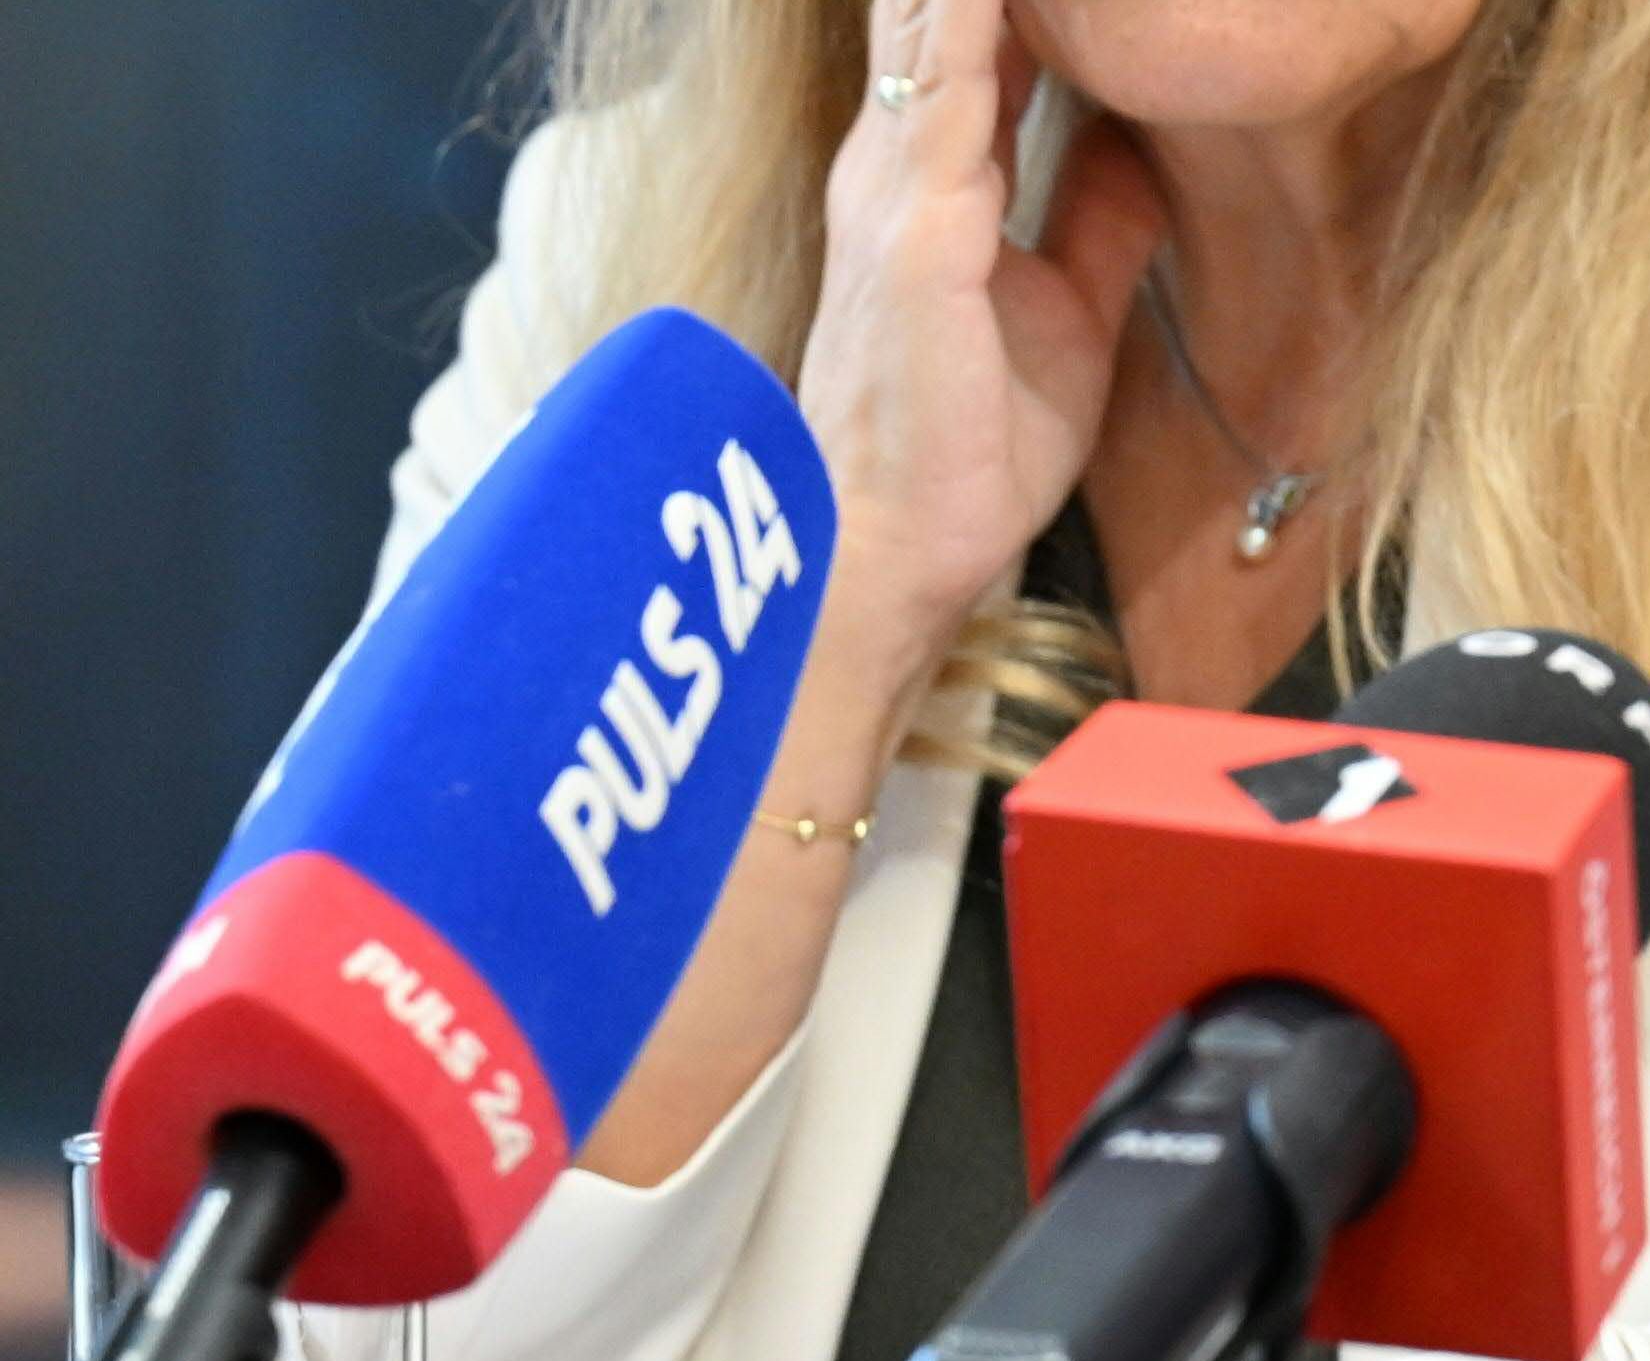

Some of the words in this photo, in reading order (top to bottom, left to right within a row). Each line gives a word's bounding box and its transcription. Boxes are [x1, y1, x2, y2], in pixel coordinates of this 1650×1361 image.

[540, 584, 723, 916] PULS
[661, 439, 803, 652] 24
[341, 940, 486, 1081] PULS
[468, 1074, 534, 1177] 24
